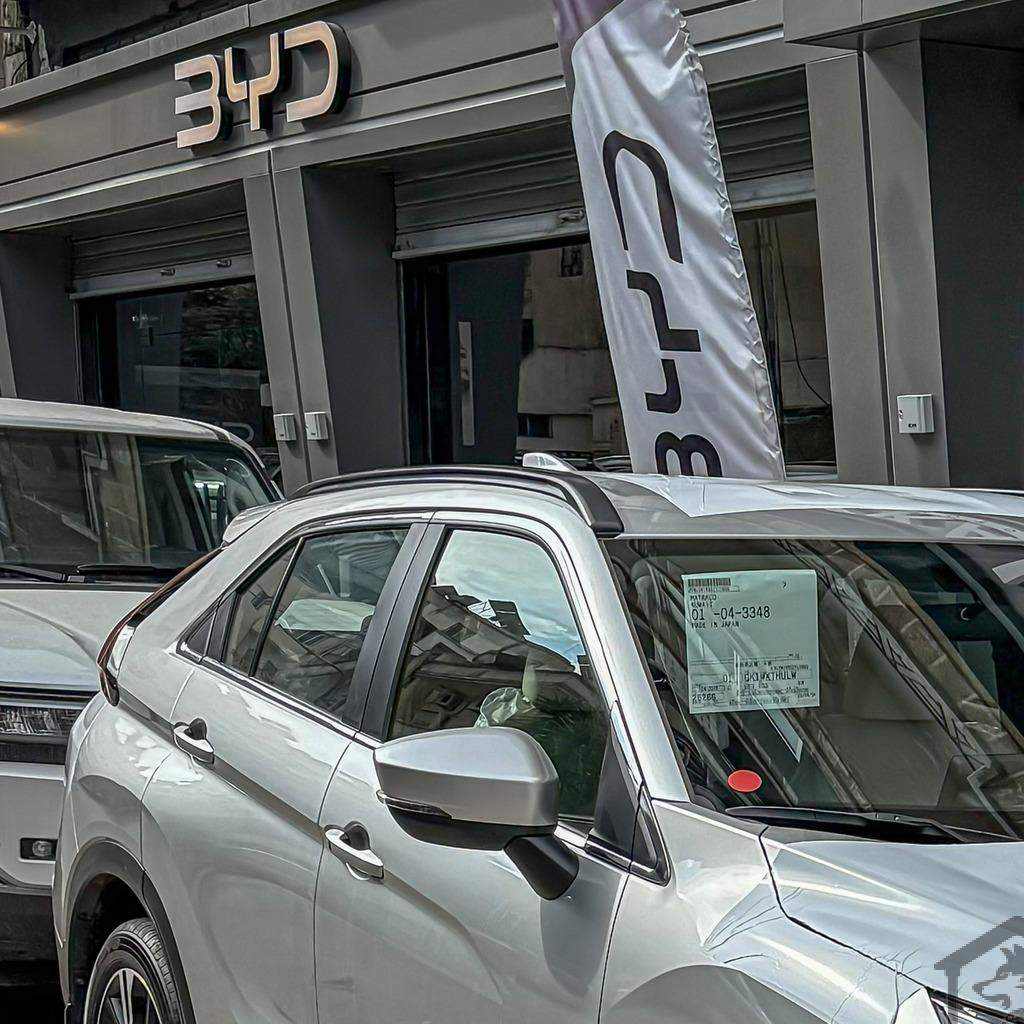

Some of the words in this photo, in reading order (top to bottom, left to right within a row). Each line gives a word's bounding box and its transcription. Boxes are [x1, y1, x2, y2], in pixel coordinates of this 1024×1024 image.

[174, 20, 345, 149] BYD
[602, 129, 723, 478] BYD
[713, 606, 771, 620] -04-3348
